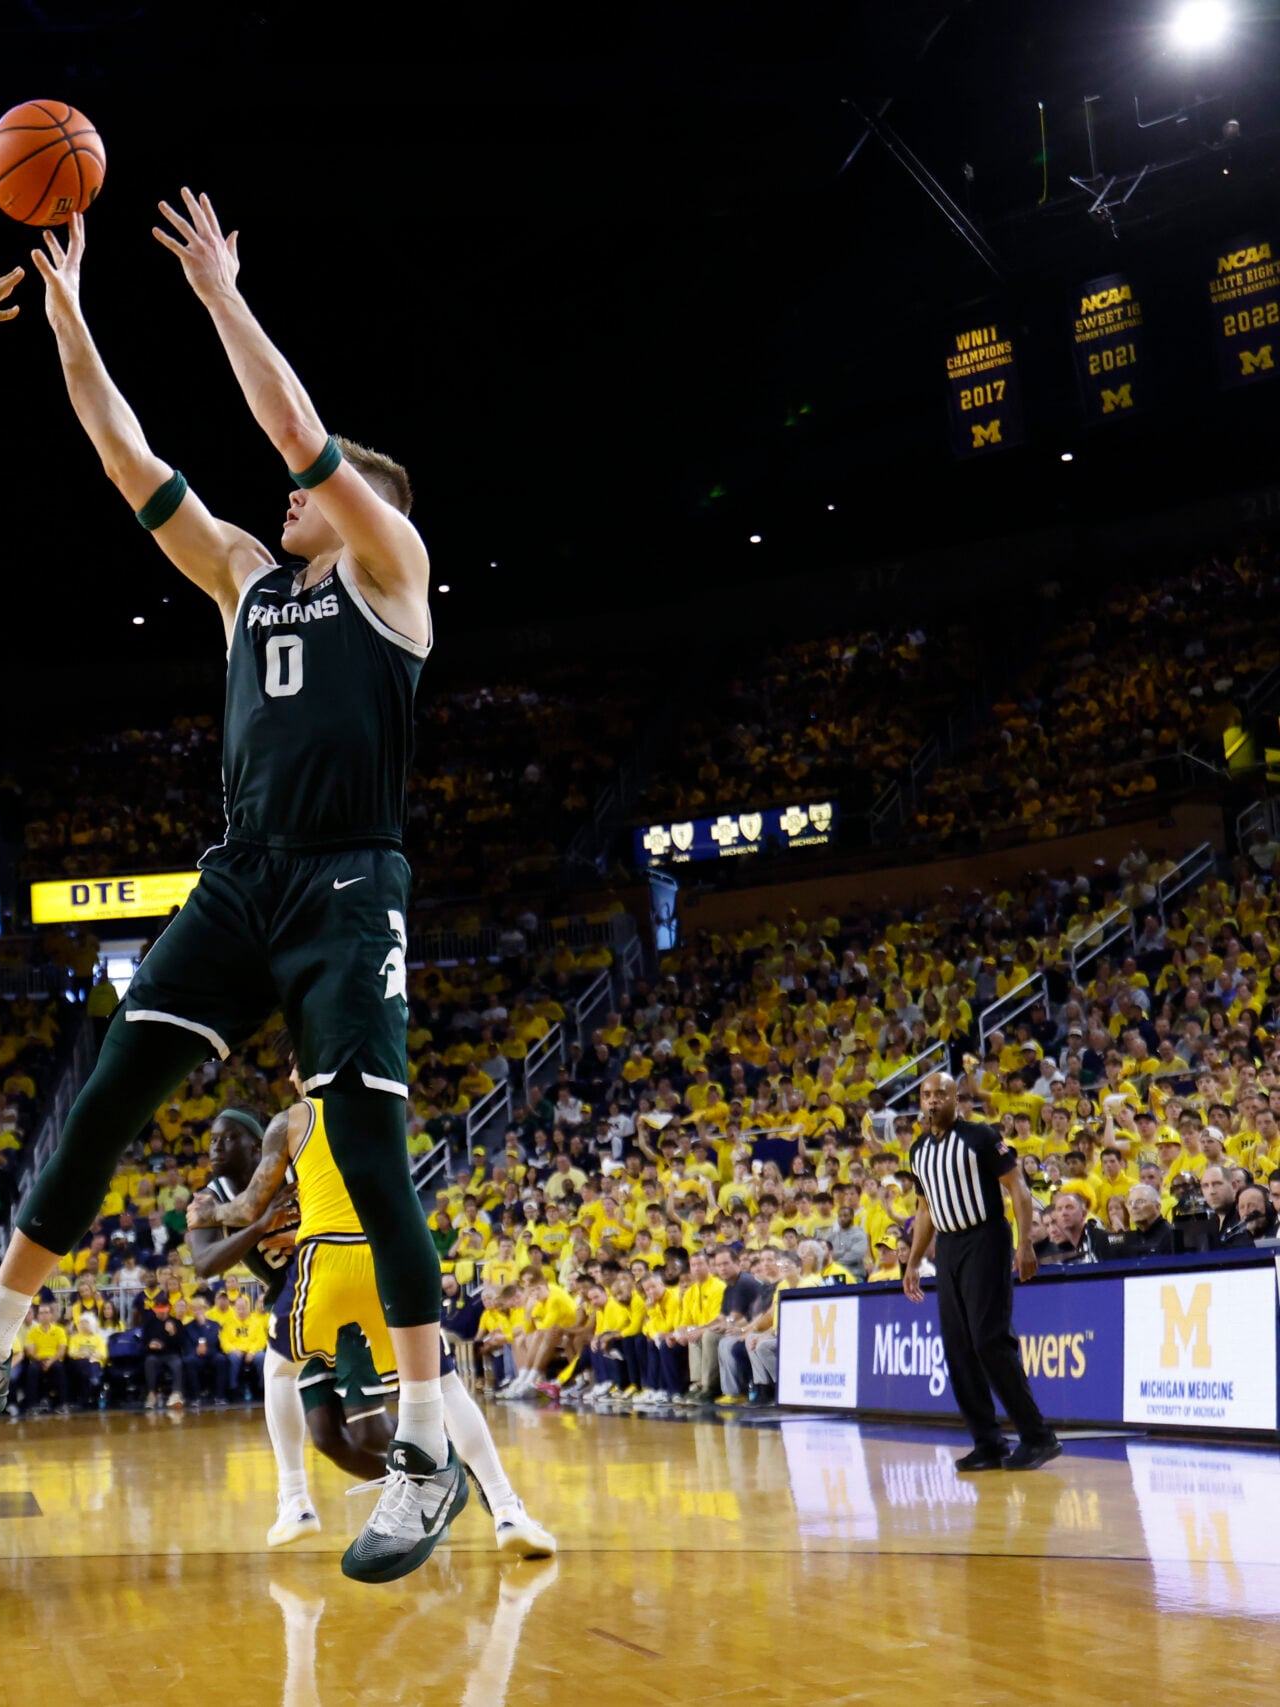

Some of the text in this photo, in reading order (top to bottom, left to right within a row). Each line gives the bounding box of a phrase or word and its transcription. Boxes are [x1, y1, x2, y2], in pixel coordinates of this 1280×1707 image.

[1217, 242, 1273, 275] NCAA
[1209, 272, 1243, 294] ELITE
[1080, 284, 1133, 315] NCAA
[1075, 303, 1142, 333] SWEET 16
[1223, 302, 1280, 337] 2022
[954, 324, 998, 352] WNIT
[945, 339, 1013, 370] CHAMPIONS
[1088, 343, 1137, 375] 2021
[1239, 345, 1274, 375] M
[960, 379, 1006, 411] 2017
[1101, 383, 1134, 414] M
[971, 419, 1002, 449] M
[247, 593, 340, 630] SARTANS
[265, 634, 304, 698] 0
[719, 844, 758, 857] MICHIGAN
[788, 835, 829, 848] MICHIGAN
[71, 881, 135, 906] DTE
[810, 1303, 837, 1364] M
[1160, 1282, 1213, 1369] M
[873, 1320, 949, 1397] Michig
[1140, 1380, 1234, 1401] MICHIGAN MEDICINE
[1146, 1404, 1226, 1418] UNIVERSITY OF MICHIGAN
